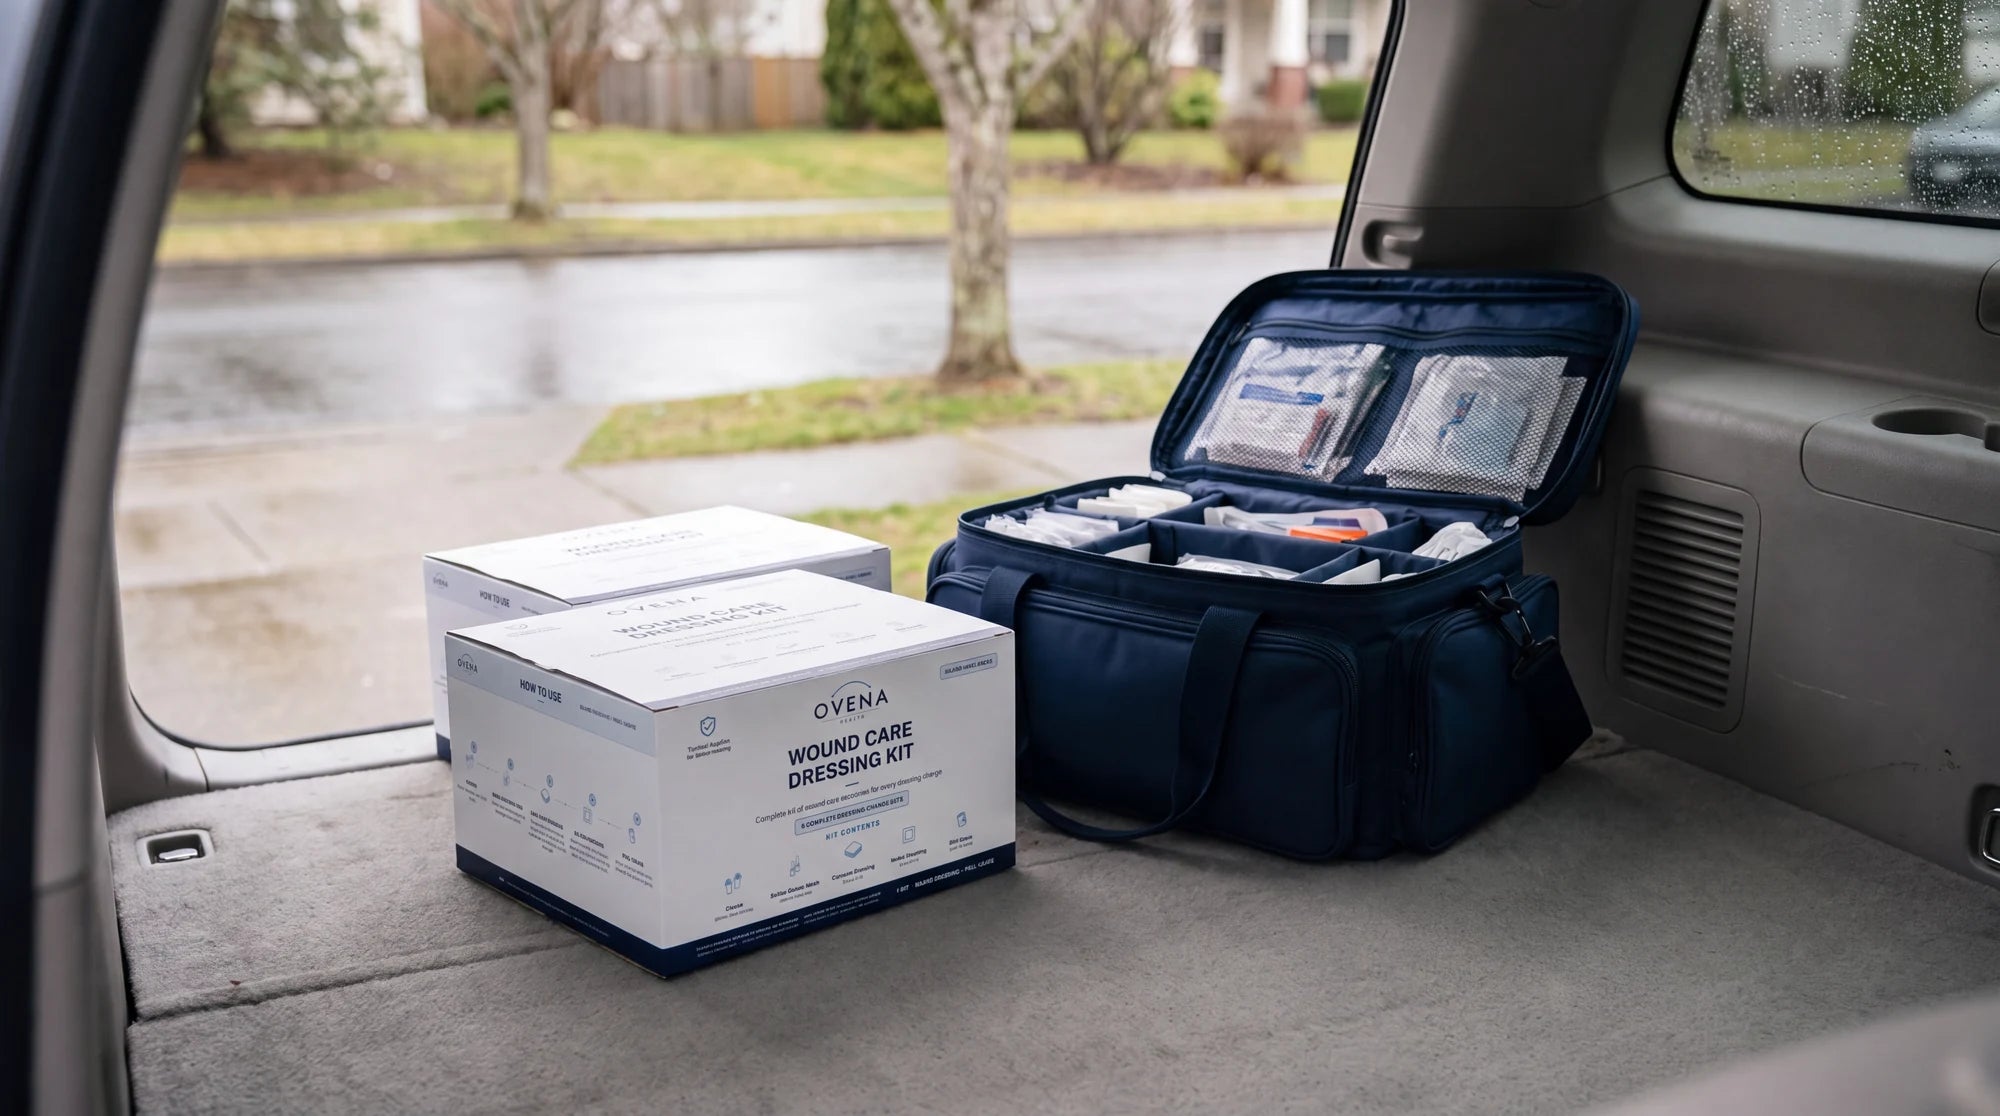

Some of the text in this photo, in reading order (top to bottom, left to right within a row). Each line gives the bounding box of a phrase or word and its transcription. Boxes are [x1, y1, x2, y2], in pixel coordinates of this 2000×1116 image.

[613, 614, 706, 634] WOUND
[710, 601, 775, 616] CARE
[628, 613, 749, 640] DRESSING
[750, 605, 788, 616] KIT
[520, 678, 562, 704] HOW TO USE
[814, 688, 889, 720] OVENA
[788, 720, 913, 766] WOUND CARE
[788, 742, 914, 790] DRESSING KIT
[840, 819, 880, 837] CONTENTS
